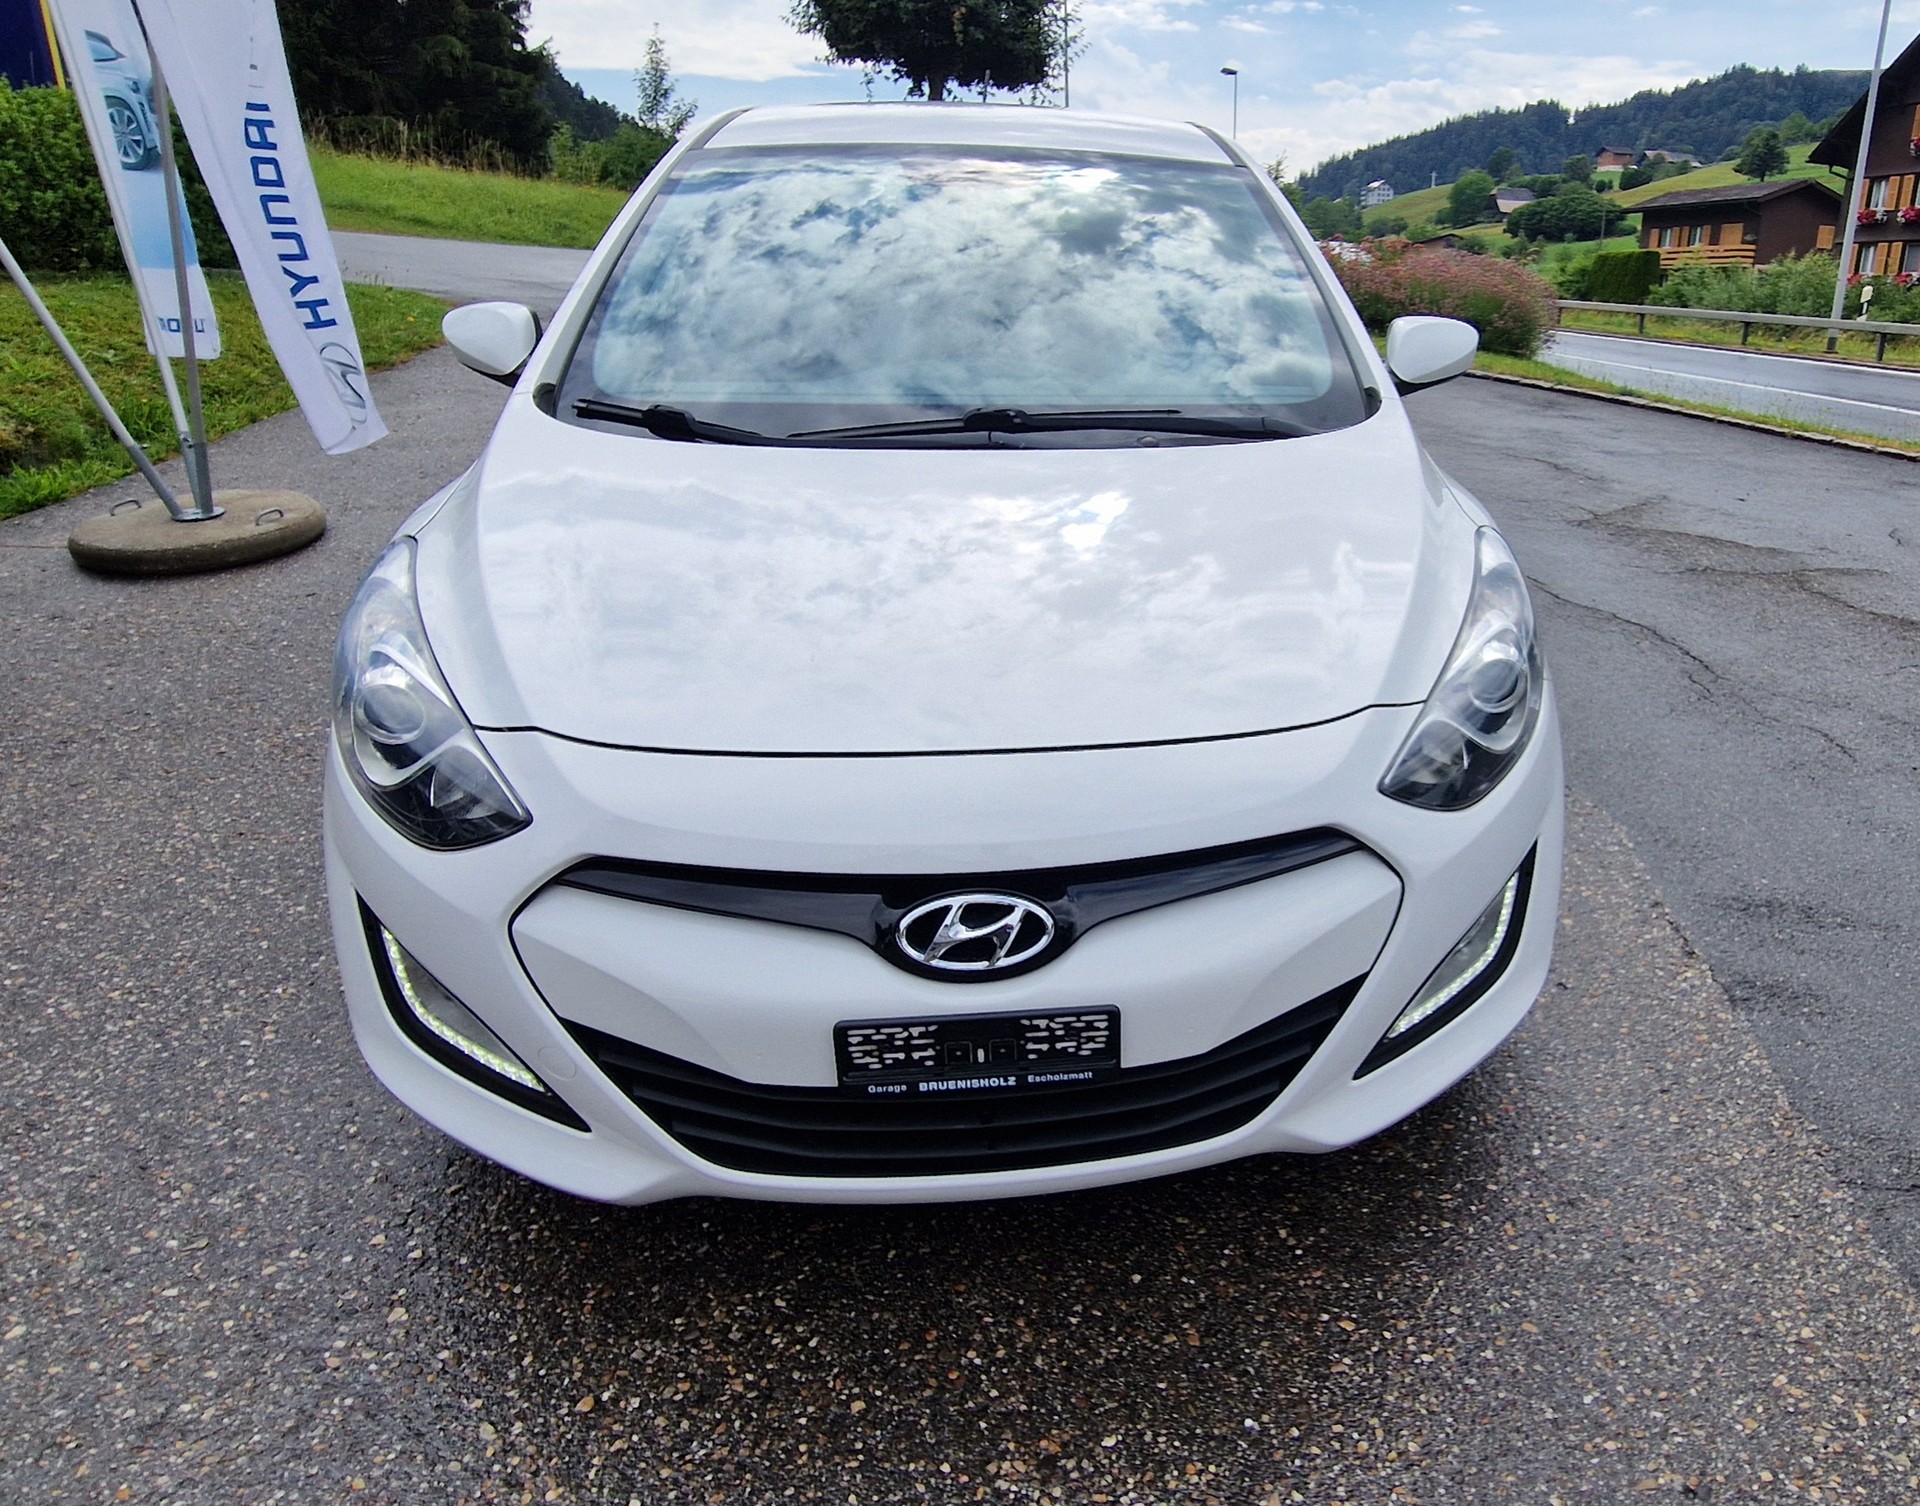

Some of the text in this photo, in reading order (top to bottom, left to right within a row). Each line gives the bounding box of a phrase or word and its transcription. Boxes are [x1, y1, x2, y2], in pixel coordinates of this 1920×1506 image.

[244, 102, 338, 330] HYUNDAI
[867, 1071, 1093, 1093] Garage BRUENISHOLZ Escholzmatt
